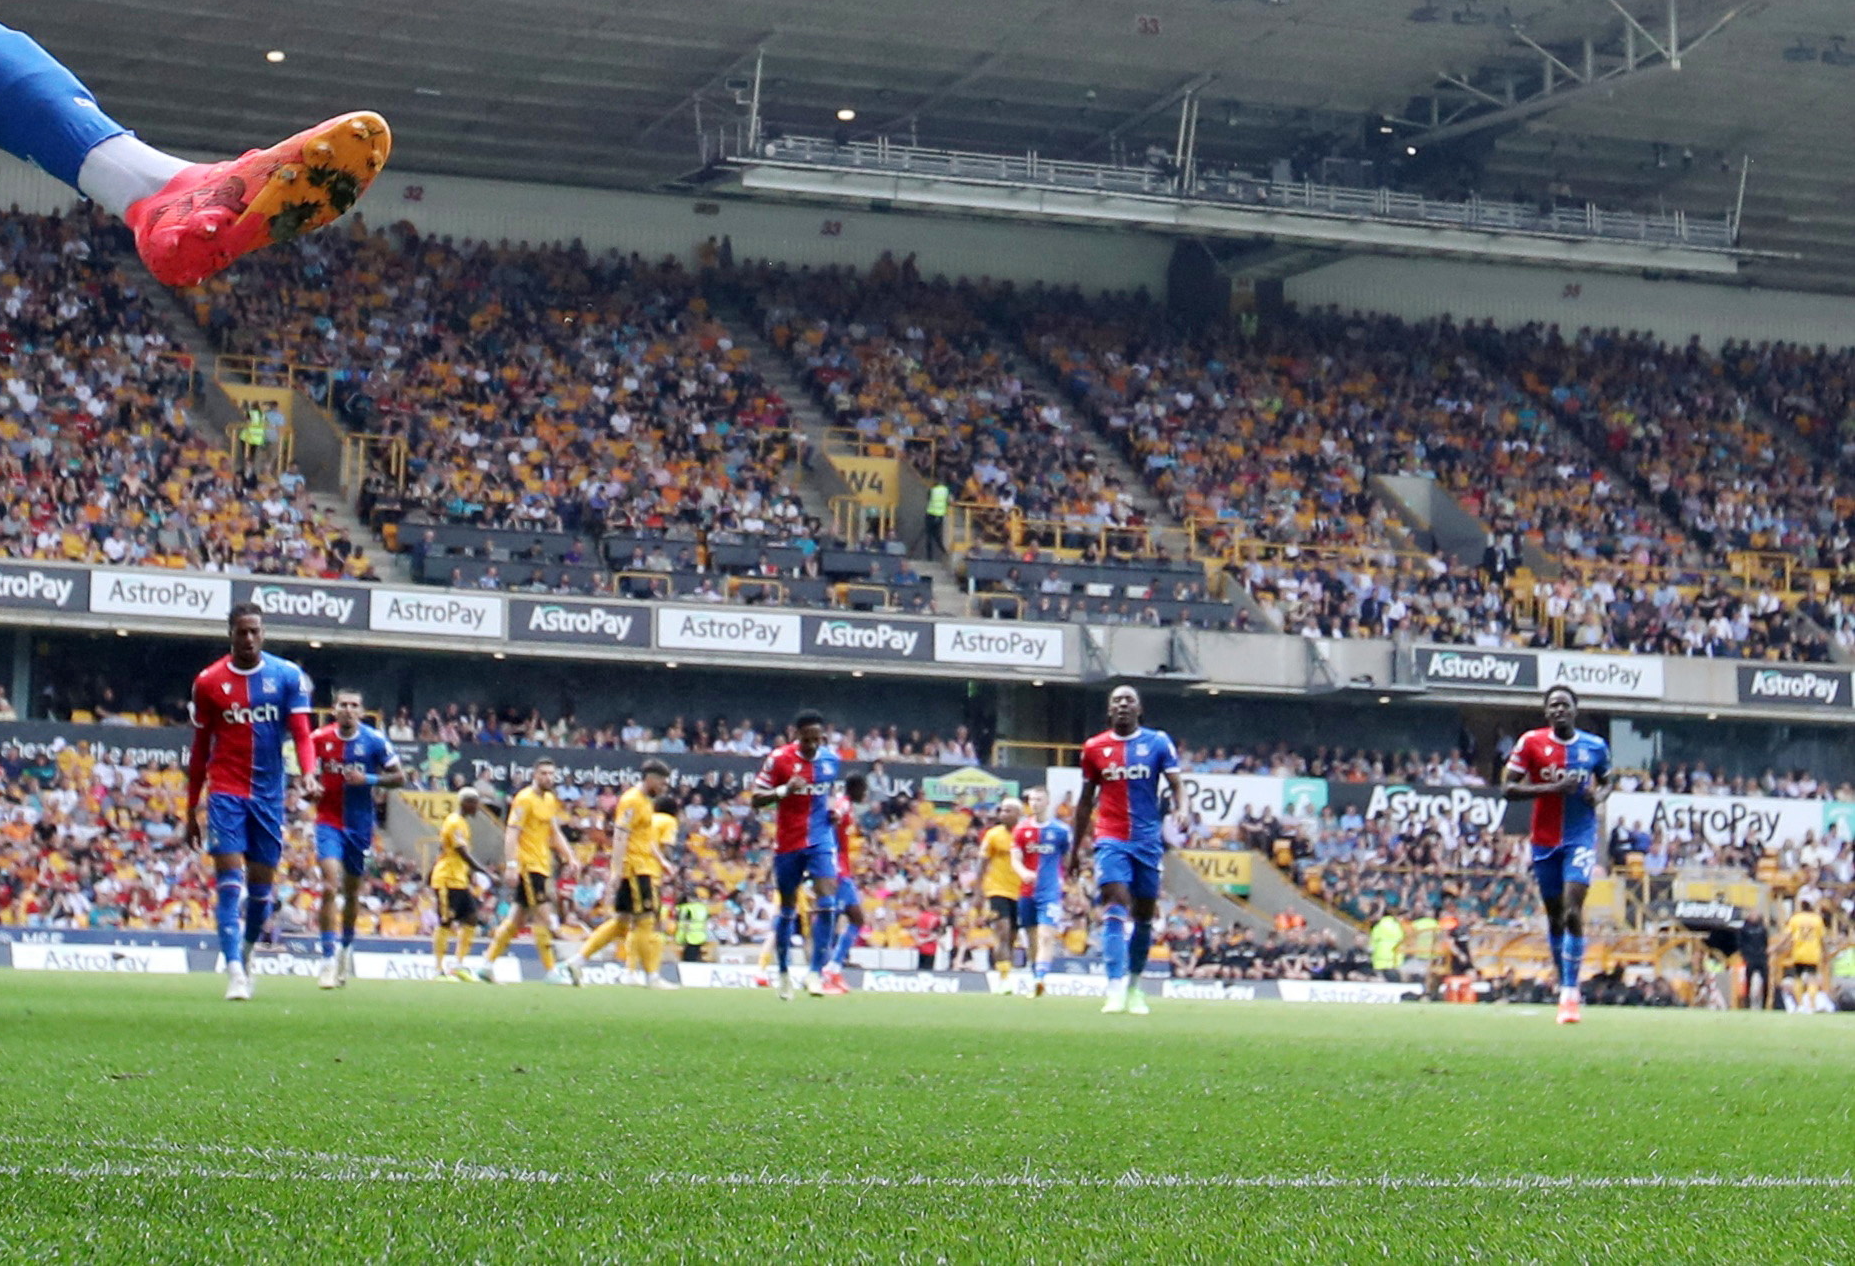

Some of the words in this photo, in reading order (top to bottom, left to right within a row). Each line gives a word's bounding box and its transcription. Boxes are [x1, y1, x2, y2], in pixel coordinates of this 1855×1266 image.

[109, 578, 213, 613] AstroPay
[250, 585, 354, 623] AstroPay
[387, 597, 487, 630] AstroPay
[528, 605, 633, 641] AstroPay
[679, 614, 782, 646] AstroPay
[815, 620, 919, 657] AstroPay
[950, 629, 1048, 661] AstroPay
[1427, 651, 1521, 686] AstroPay
[1554, 660, 1644, 691] AstroPay
[1750, 668, 1840, 705] AstroPay
[222, 702, 279, 725] cinch
[471, 759, 506, 782] The
[1100, 763, 1151, 781] cinch
[1539, 764, 1590, 782] cinch
[1365, 783, 1509, 833] AstroPay
[1649, 799, 1781, 841] AstroPay
[1189, 853, 1240, 877] WL4
[45, 949, 150, 972] AstroPay
